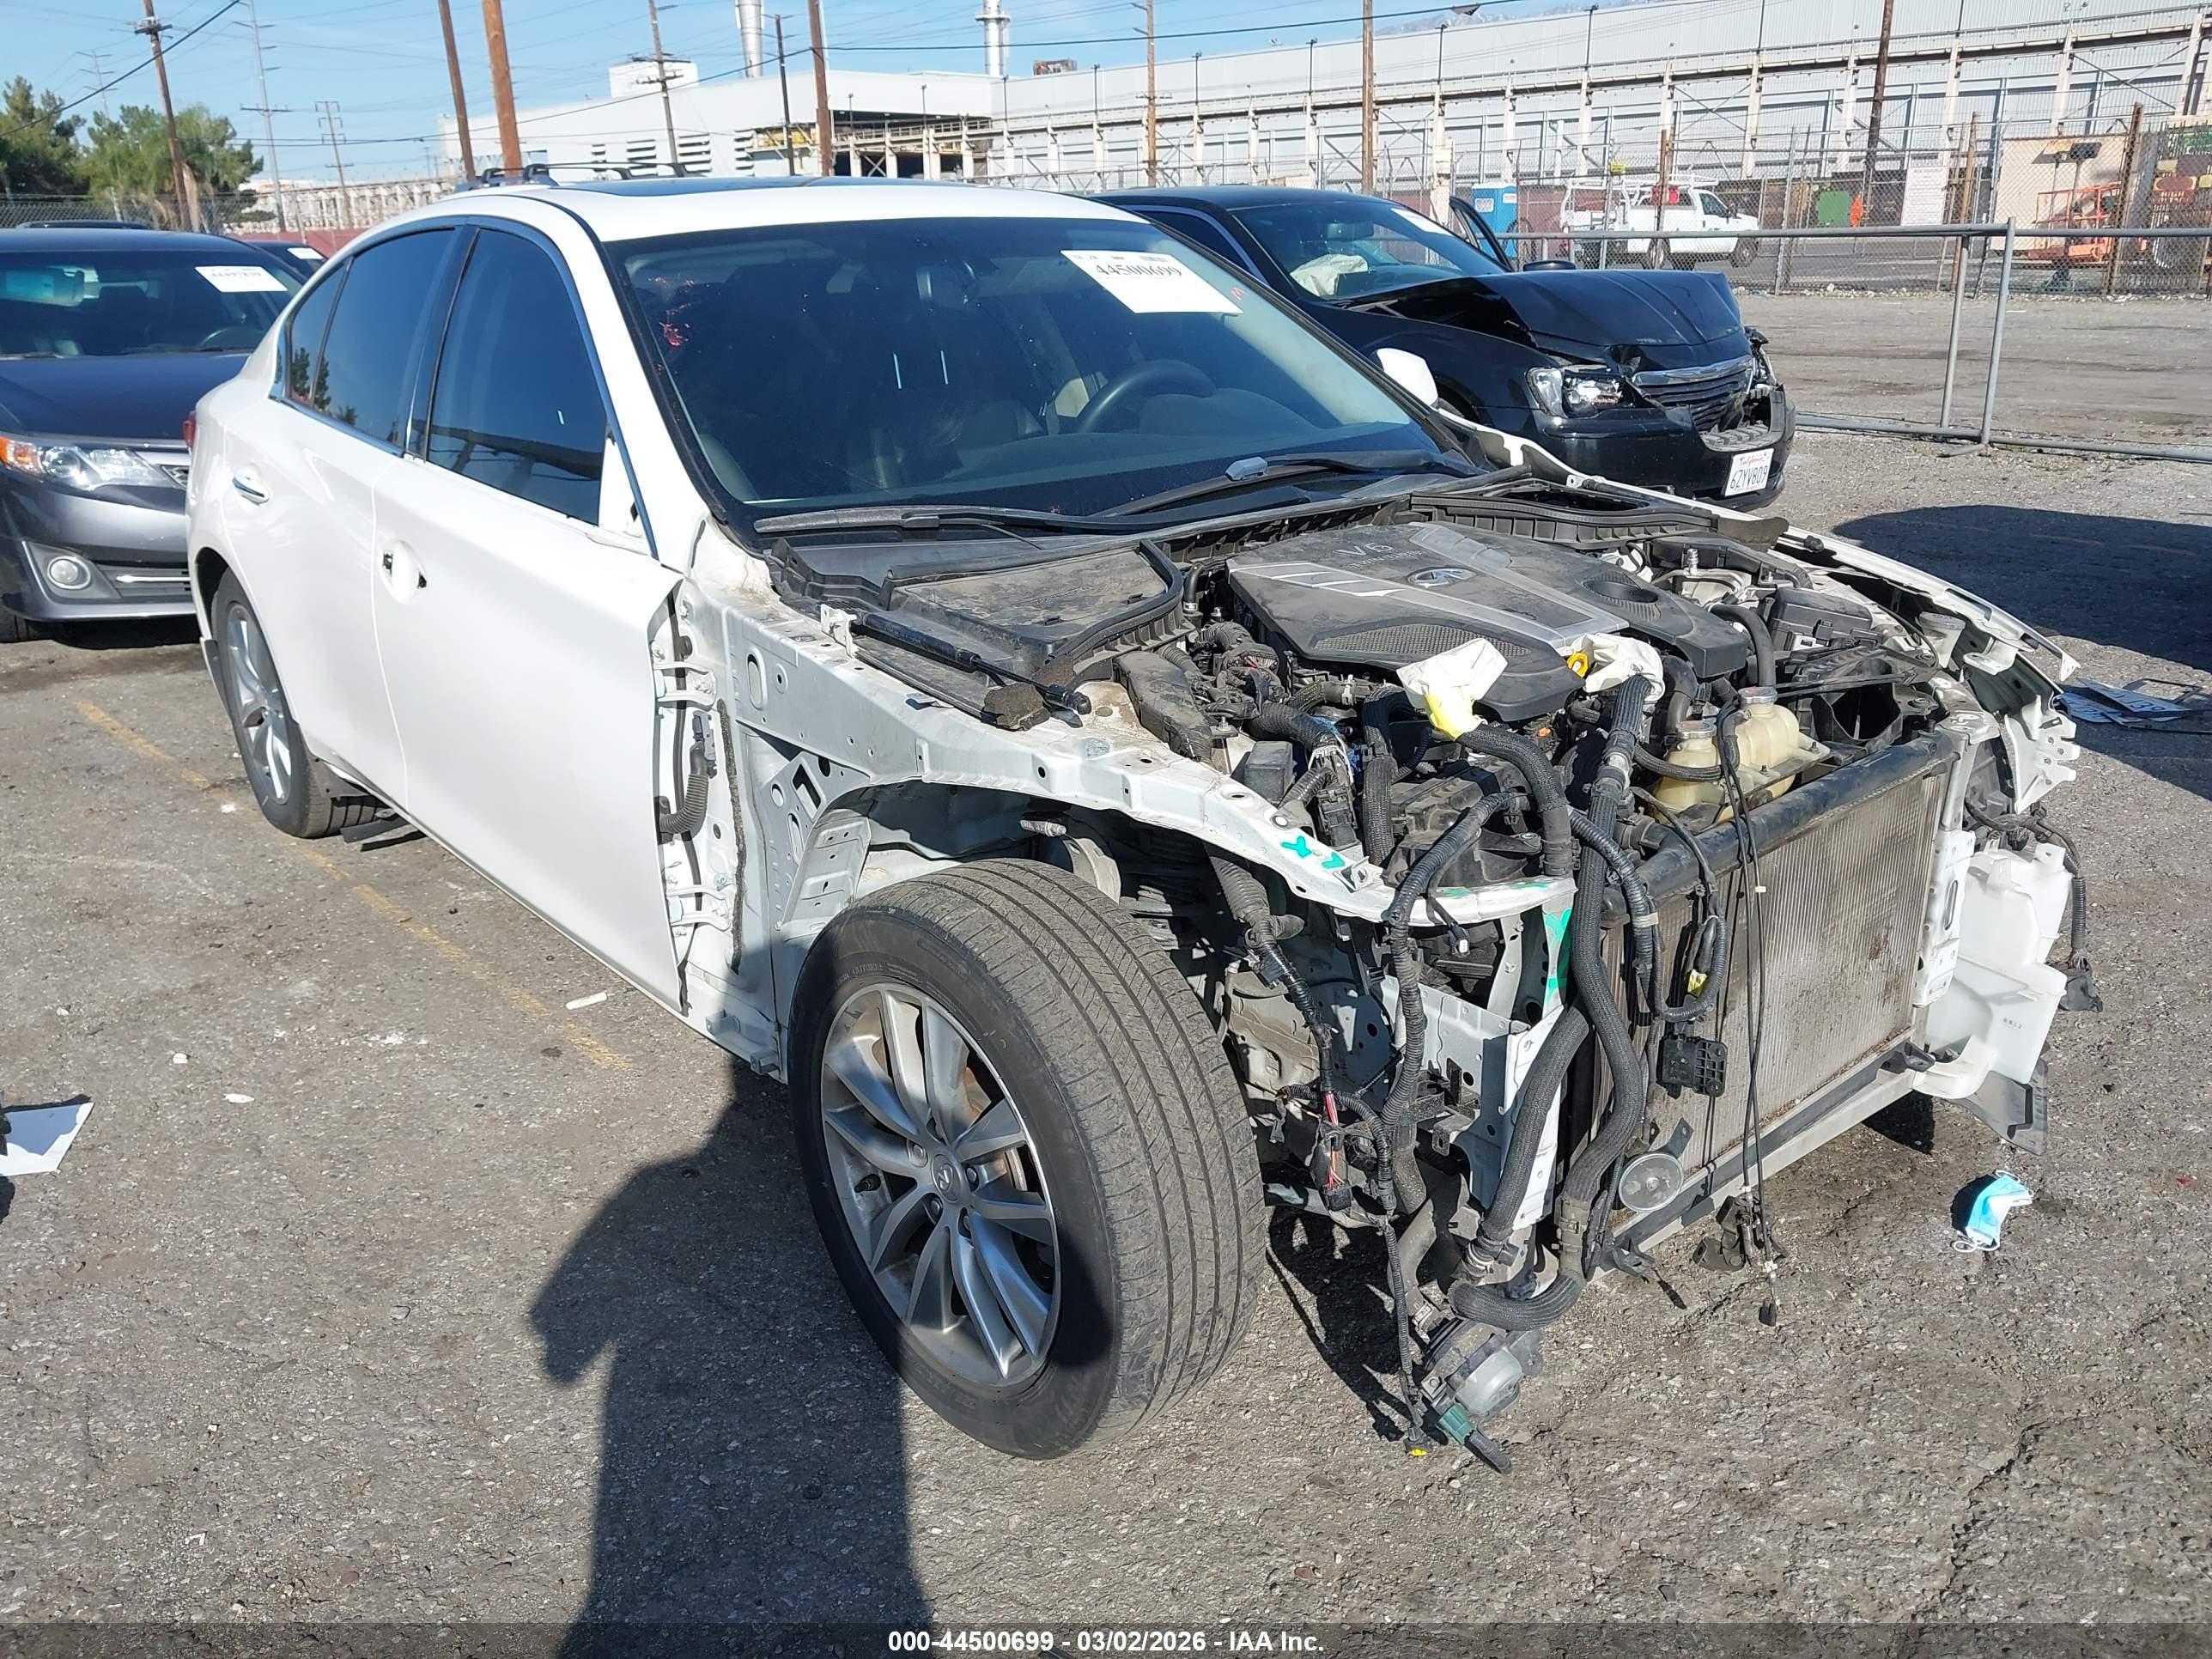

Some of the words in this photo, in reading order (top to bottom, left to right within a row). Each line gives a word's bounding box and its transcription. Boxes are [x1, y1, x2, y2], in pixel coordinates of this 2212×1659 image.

[1097, 264, 1182, 276] 44500699
[1729, 465, 1768, 489] 6ZYV809
[1333, 543, 1395, 557] V6
